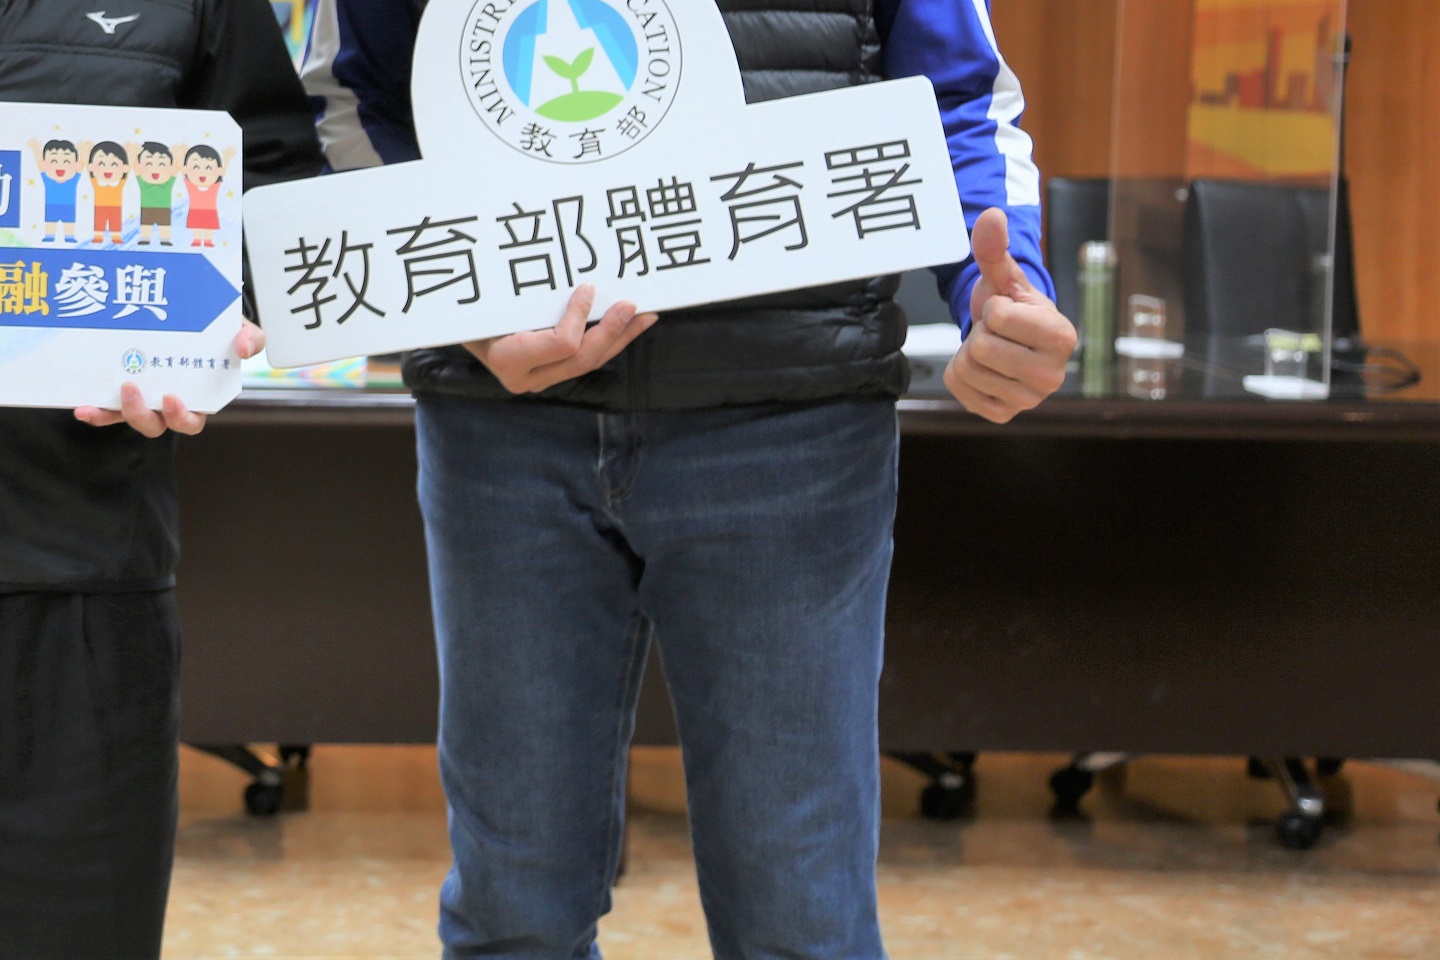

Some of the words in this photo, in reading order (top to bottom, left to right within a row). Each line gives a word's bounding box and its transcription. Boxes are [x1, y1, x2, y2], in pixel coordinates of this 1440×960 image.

[519, 105, 650, 160] 教育部
[282, 137, 926, 332] 教育部體育署
